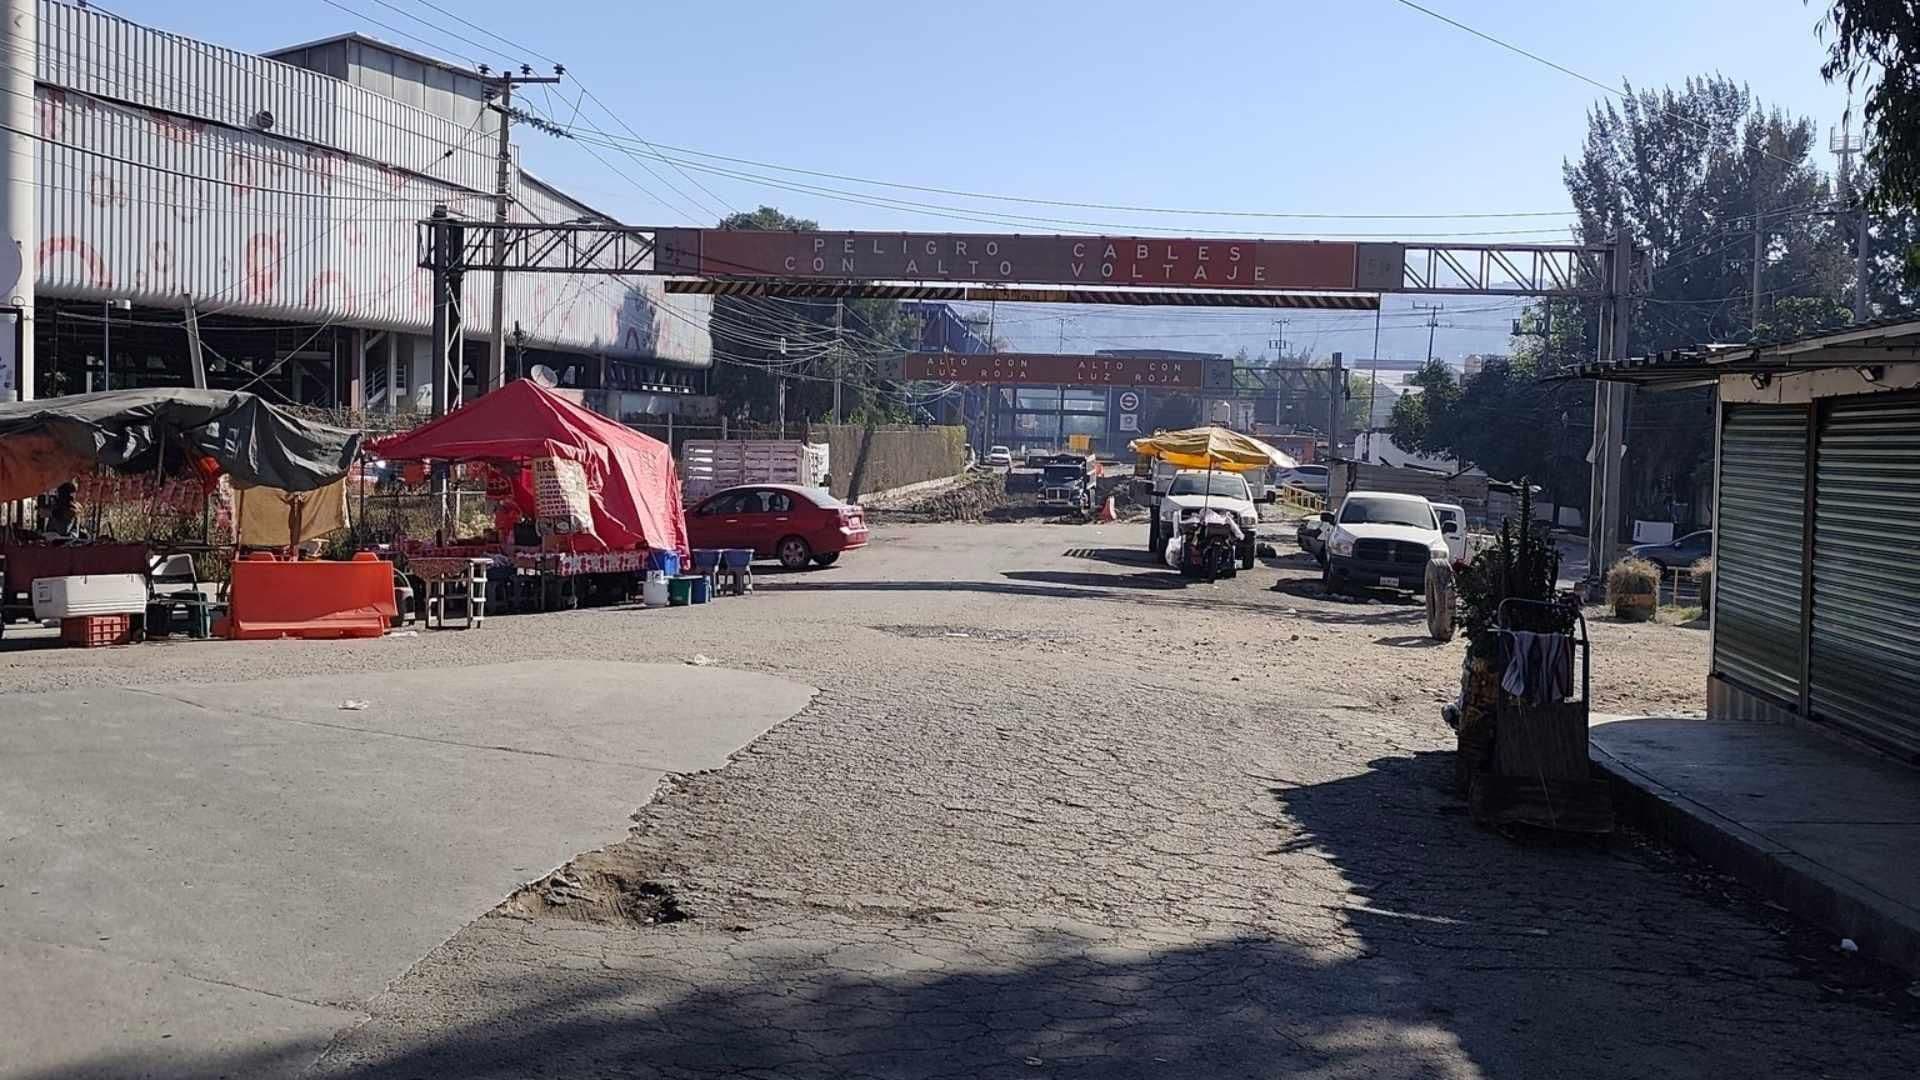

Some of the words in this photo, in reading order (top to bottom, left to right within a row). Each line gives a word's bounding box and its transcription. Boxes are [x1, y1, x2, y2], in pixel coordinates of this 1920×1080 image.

[814, 238, 999, 257] PELIGRO
[1073, 242, 1241, 262] CABLES
[784, 256, 854, 272] CON
[905, 259, 1012, 276] ALTO
[1071, 263, 1265, 281] VOLTAJE
[927, 357, 968, 367] ALTO
[994, 358, 1028, 368] CON
[1078, 361, 1124, 371] ALTO
[1149, 362, 1182, 372] CON
[926, 368, 957, 377] LUZ
[980, 369, 1027, 379] ROJA
[1078, 372, 1111, 381] LUZ
[1135, 373, 1181, 383] ROJA
